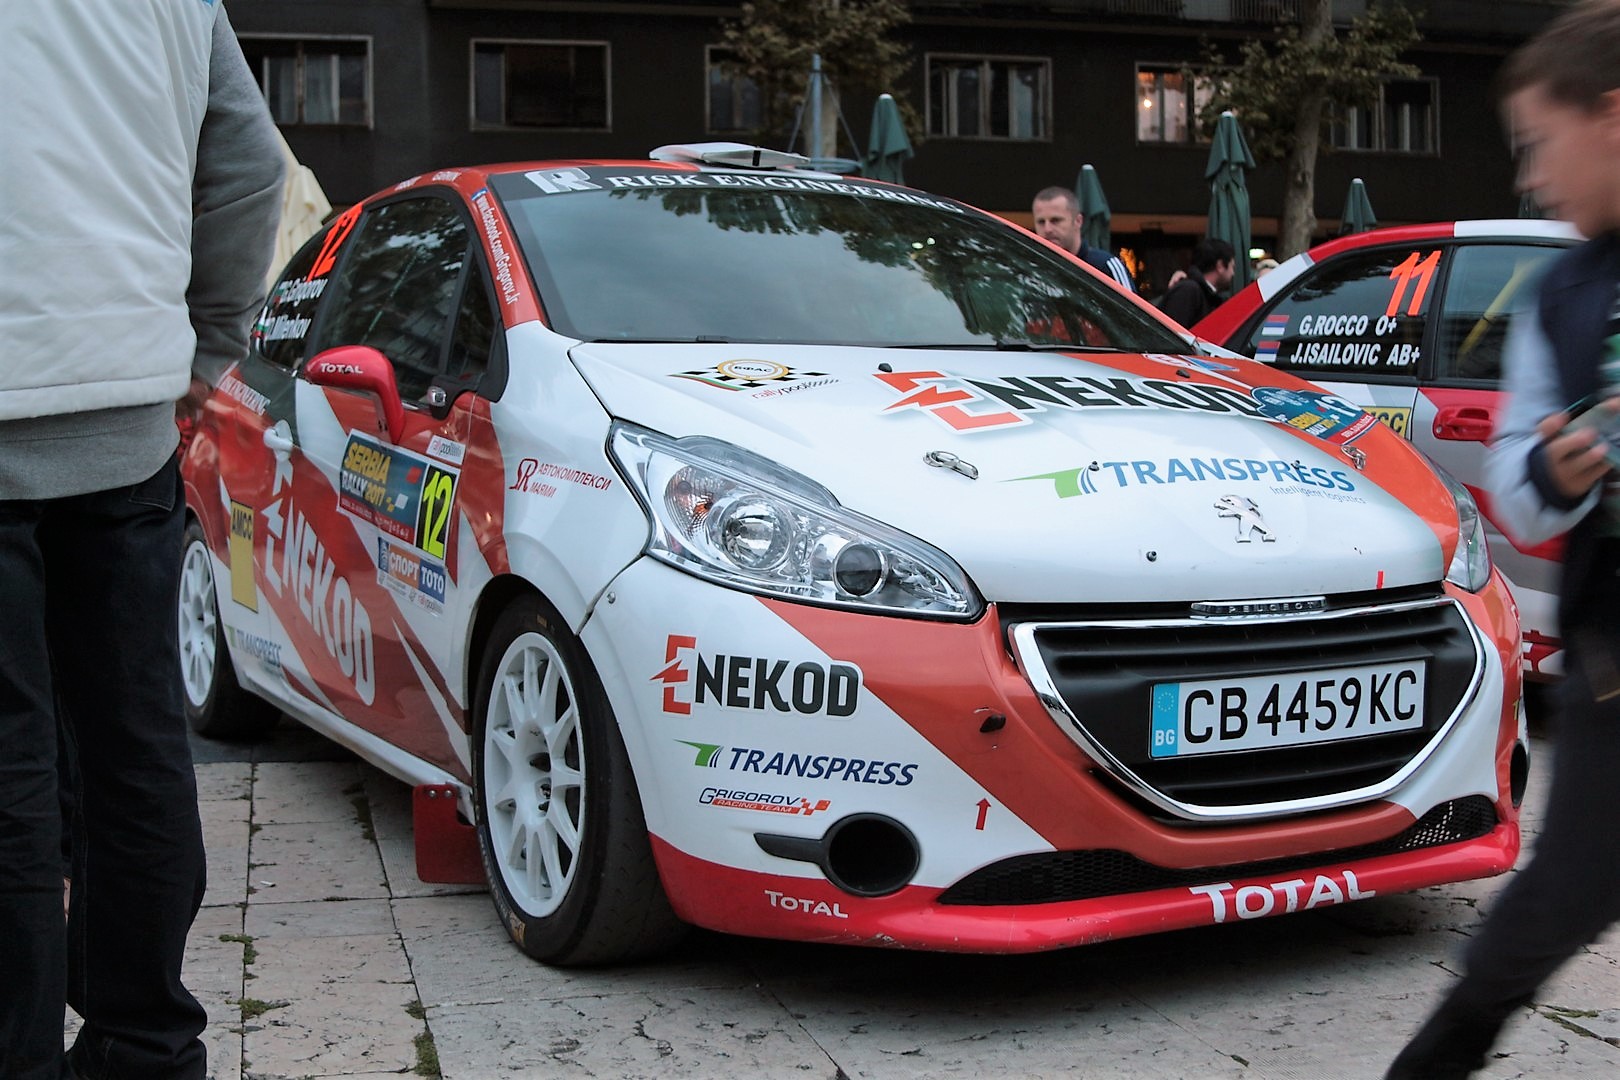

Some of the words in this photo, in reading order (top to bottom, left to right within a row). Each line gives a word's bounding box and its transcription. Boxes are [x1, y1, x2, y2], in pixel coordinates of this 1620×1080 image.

[605, 174, 709, 188] RISK
[709, 174, 964, 214] ENGINEERING
[305, 202, 363, 283] 12
[1386, 250, 1442, 317] 11
[1299, 315, 1368, 337] G.ROCCO
[321, 362, 364, 374] TOTAL
[1290, 342, 1382, 366] J.ISAILOVIC
[1386, 344, 1420, 365] AB+
[344, 442, 391, 485] SERBIA
[539, 462, 612, 491] АВТОКОМПЛЕКСИ
[1103, 458, 1356, 492] TRANSPRESS
[341, 470, 369, 498] RALLY
[364, 481, 386, 508] 2017
[231, 507, 252, 541] AMCC
[423, 471, 452, 559] 12
[389, 551, 419, 581] СПОРТ
[421, 566, 444, 594] ТОТО
[1155, 729, 1175, 746] BG
[729, 747, 919, 786] TRANSPRESS
[699, 787, 800, 806] GRIGOROV
[717, 799, 757, 811] RACING
[760, 802, 792, 813] TEAM
[764, 889, 849, 919] TOTAL
[1189, 870, 1376, 923] TOTAL
